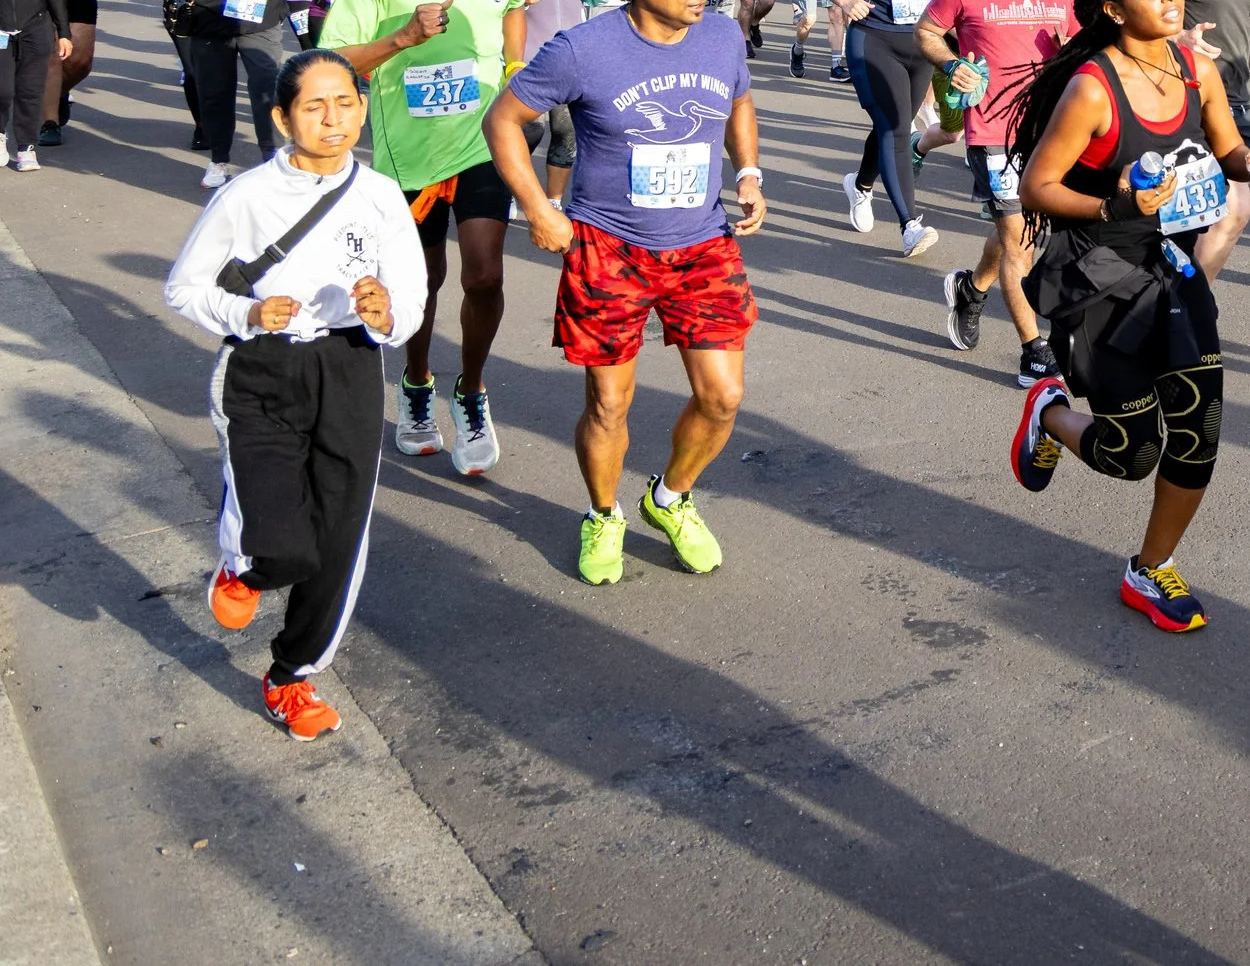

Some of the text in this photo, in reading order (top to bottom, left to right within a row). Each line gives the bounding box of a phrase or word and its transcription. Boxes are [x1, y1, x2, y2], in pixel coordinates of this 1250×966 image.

[421, 79, 465, 106] 237
[612, 73, 730, 112] DON'T CLIP MY WINGS
[648, 166, 698, 195] 592
[1175, 179, 1219, 217] 433
[1030, 362, 1047, 373] HOKA
[1201, 353, 1222, 365] oppe
[1121, 392, 1154, 411] copper
